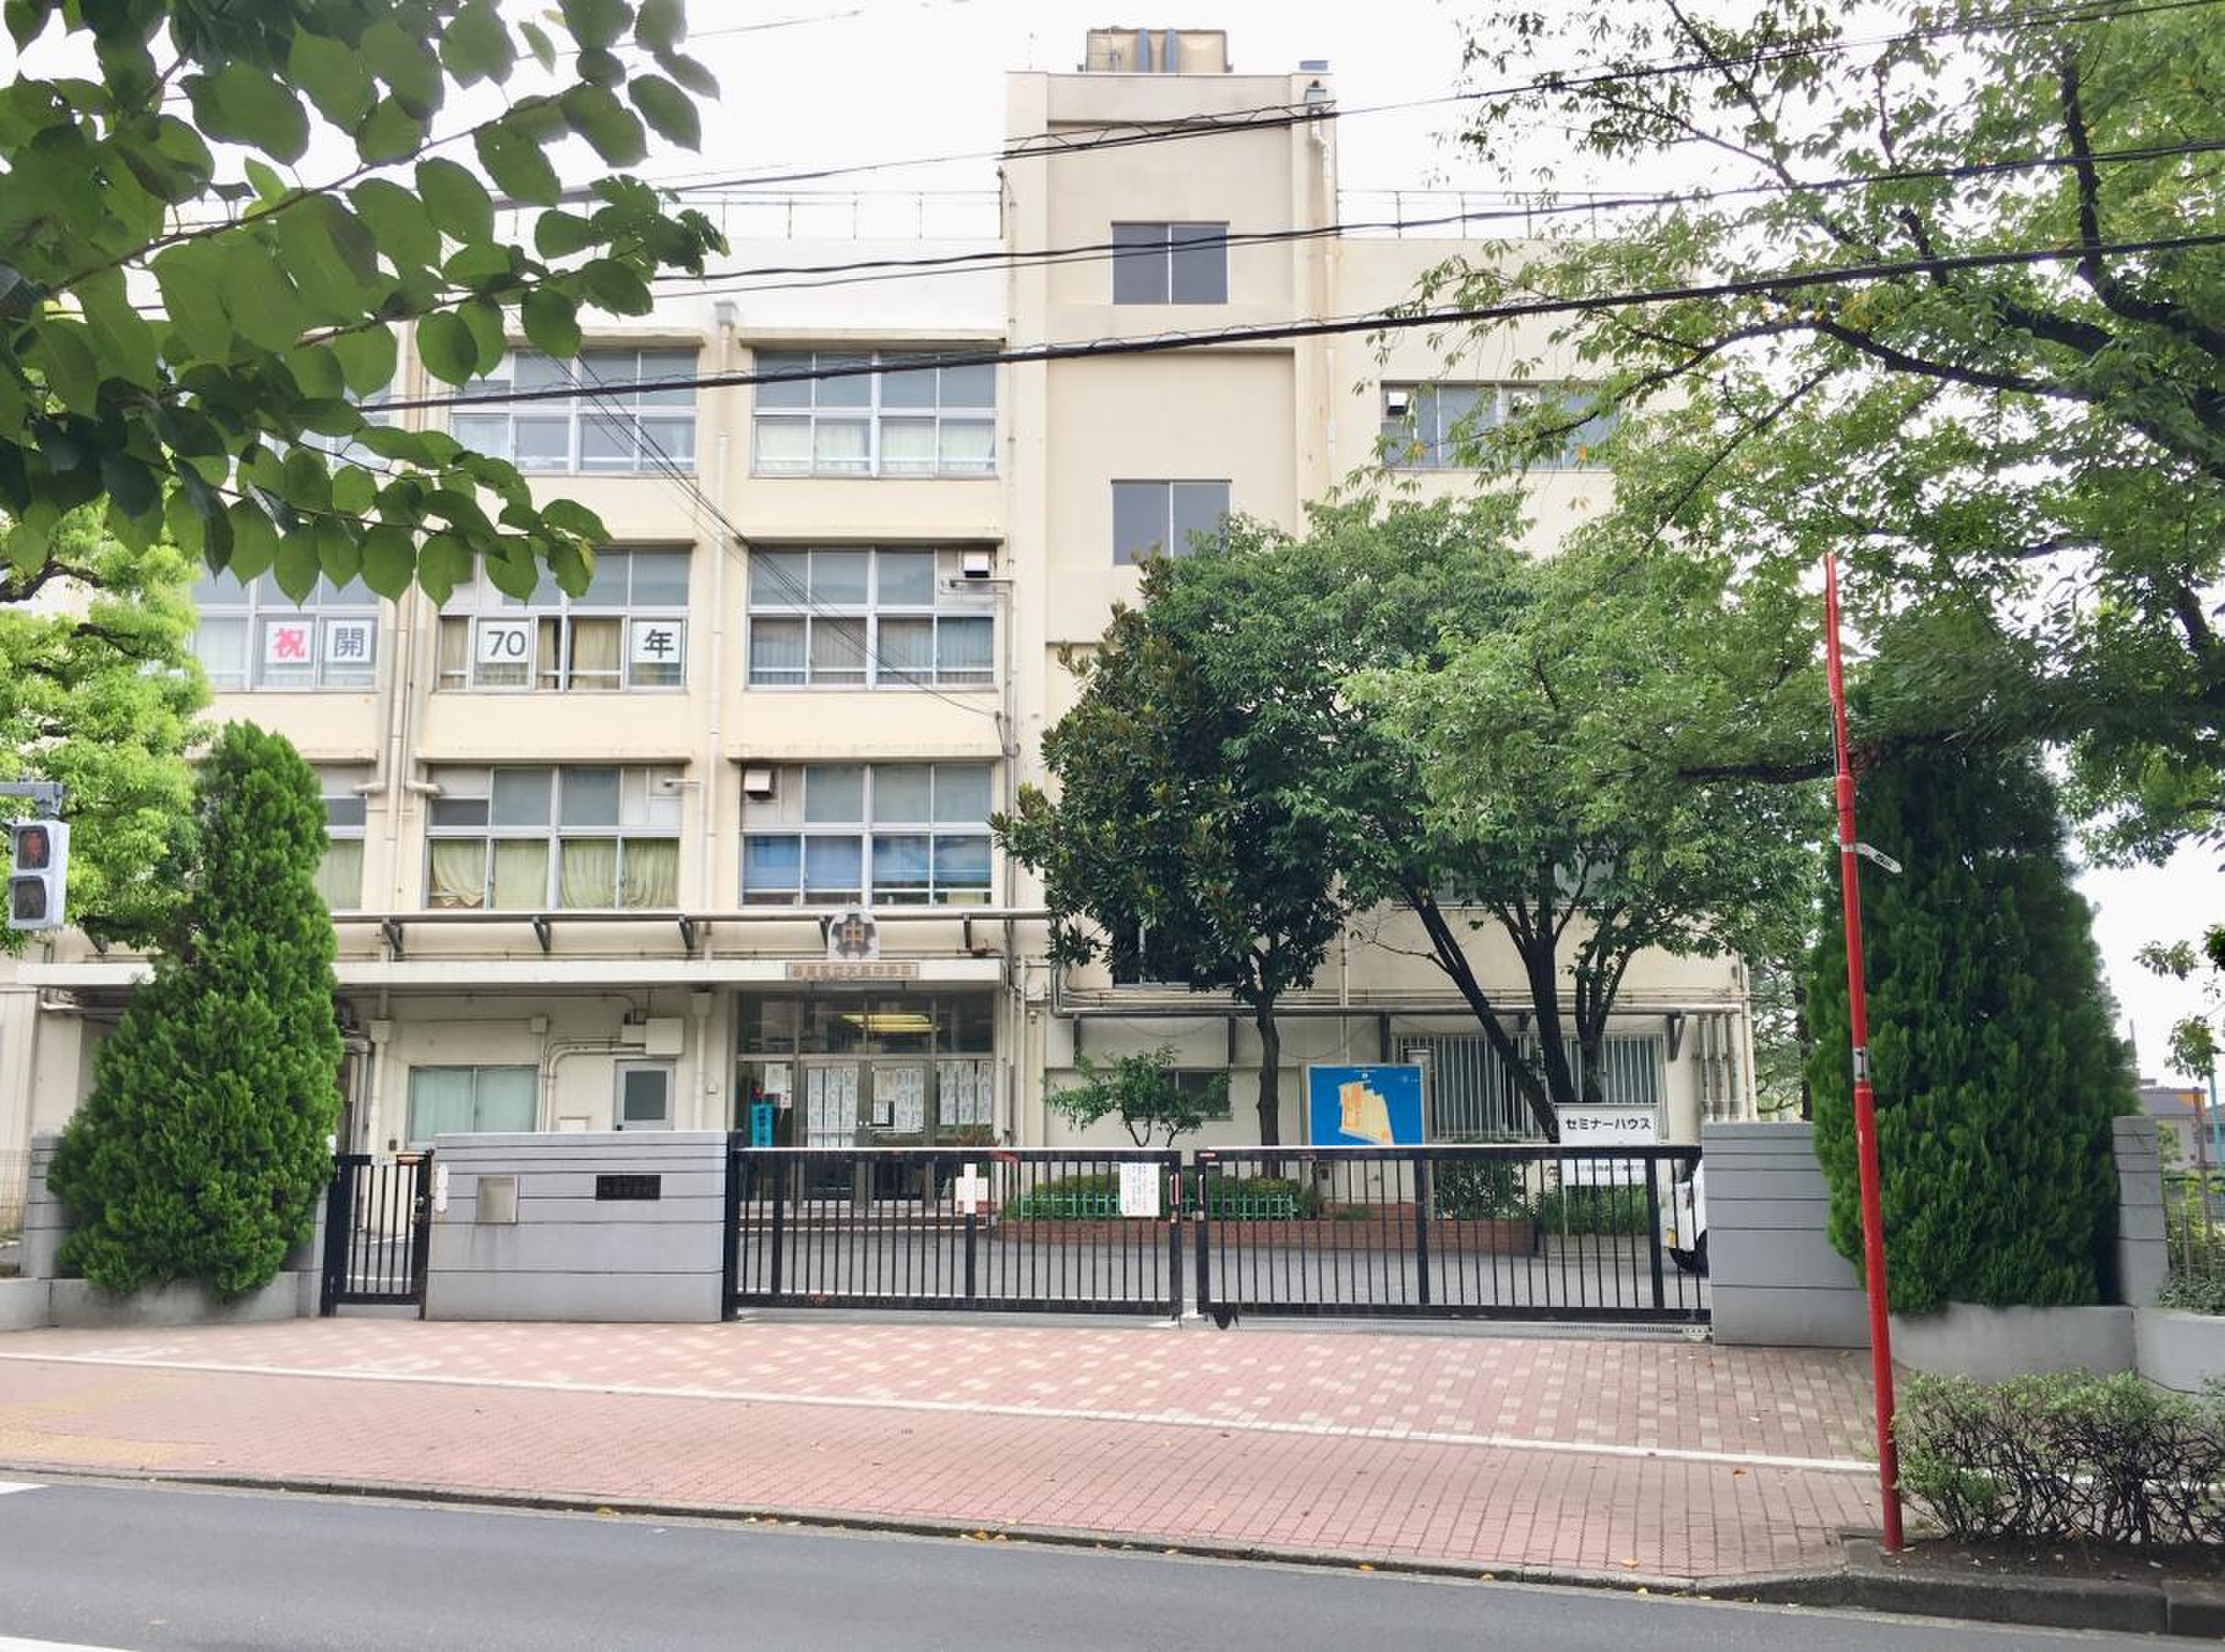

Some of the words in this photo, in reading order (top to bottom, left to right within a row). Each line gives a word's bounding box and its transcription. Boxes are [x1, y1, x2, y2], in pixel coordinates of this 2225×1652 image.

[274, 628, 306, 658] 祝
[334, 628, 364, 657] 開
[486, 630, 526, 657] 70
[643, 629, 675, 659] 年
[1566, 1118, 1651, 1130] セミナーハウス
